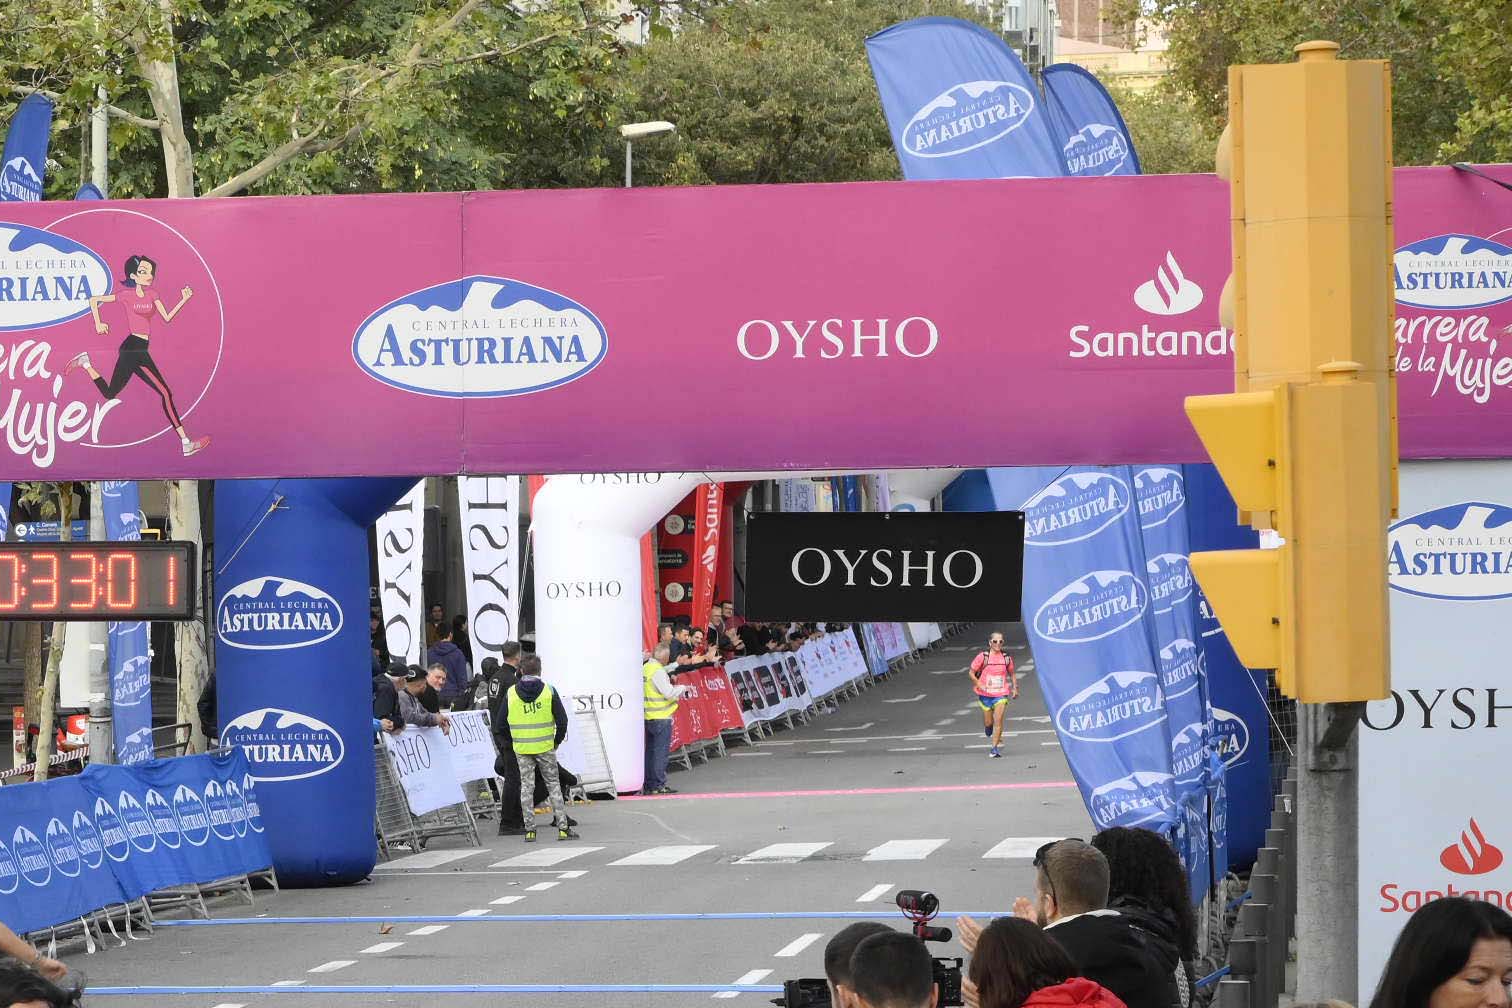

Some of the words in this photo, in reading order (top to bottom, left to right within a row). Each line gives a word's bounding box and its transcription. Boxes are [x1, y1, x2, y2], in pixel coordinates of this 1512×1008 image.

[14, 258, 87, 271] LECHERA
[1465, 258, 1512, 268] LECHER
[411, 319, 491, 332] CENTRAL
[498, 316, 580, 330] LECHERA
[1395, 314, 1490, 344] arrera
[373, 323, 587, 367] ASTURIANA
[736, 317, 939, 361] OYSHO
[1069, 322, 1236, 359] Santand
[1417, 344, 1436, 372] la
[1431, 338, 1512, 404] Muje
[704, 483, 719, 541] Sant
[1414, 536, 1482, 548] CENTRAL
[791, 548, 983, 589] OYSHO
[1388, 540, 1512, 577] ASTURIA
[545, 580, 622, 601] OYSHO
[221, 605, 334, 633] ASTURIANA
[233, 601, 276, 610] CENTRAL
[280, 601, 329, 610] LECHERA
[576, 693, 623, 711] SHO
[1362, 685, 1512, 732] OYSH
[226, 738, 334, 762] TURIANA
[235, 733, 277, 742] CENTRAL
[281, 732, 330, 741] LECHERA
[393, 734, 431, 778] SHO
